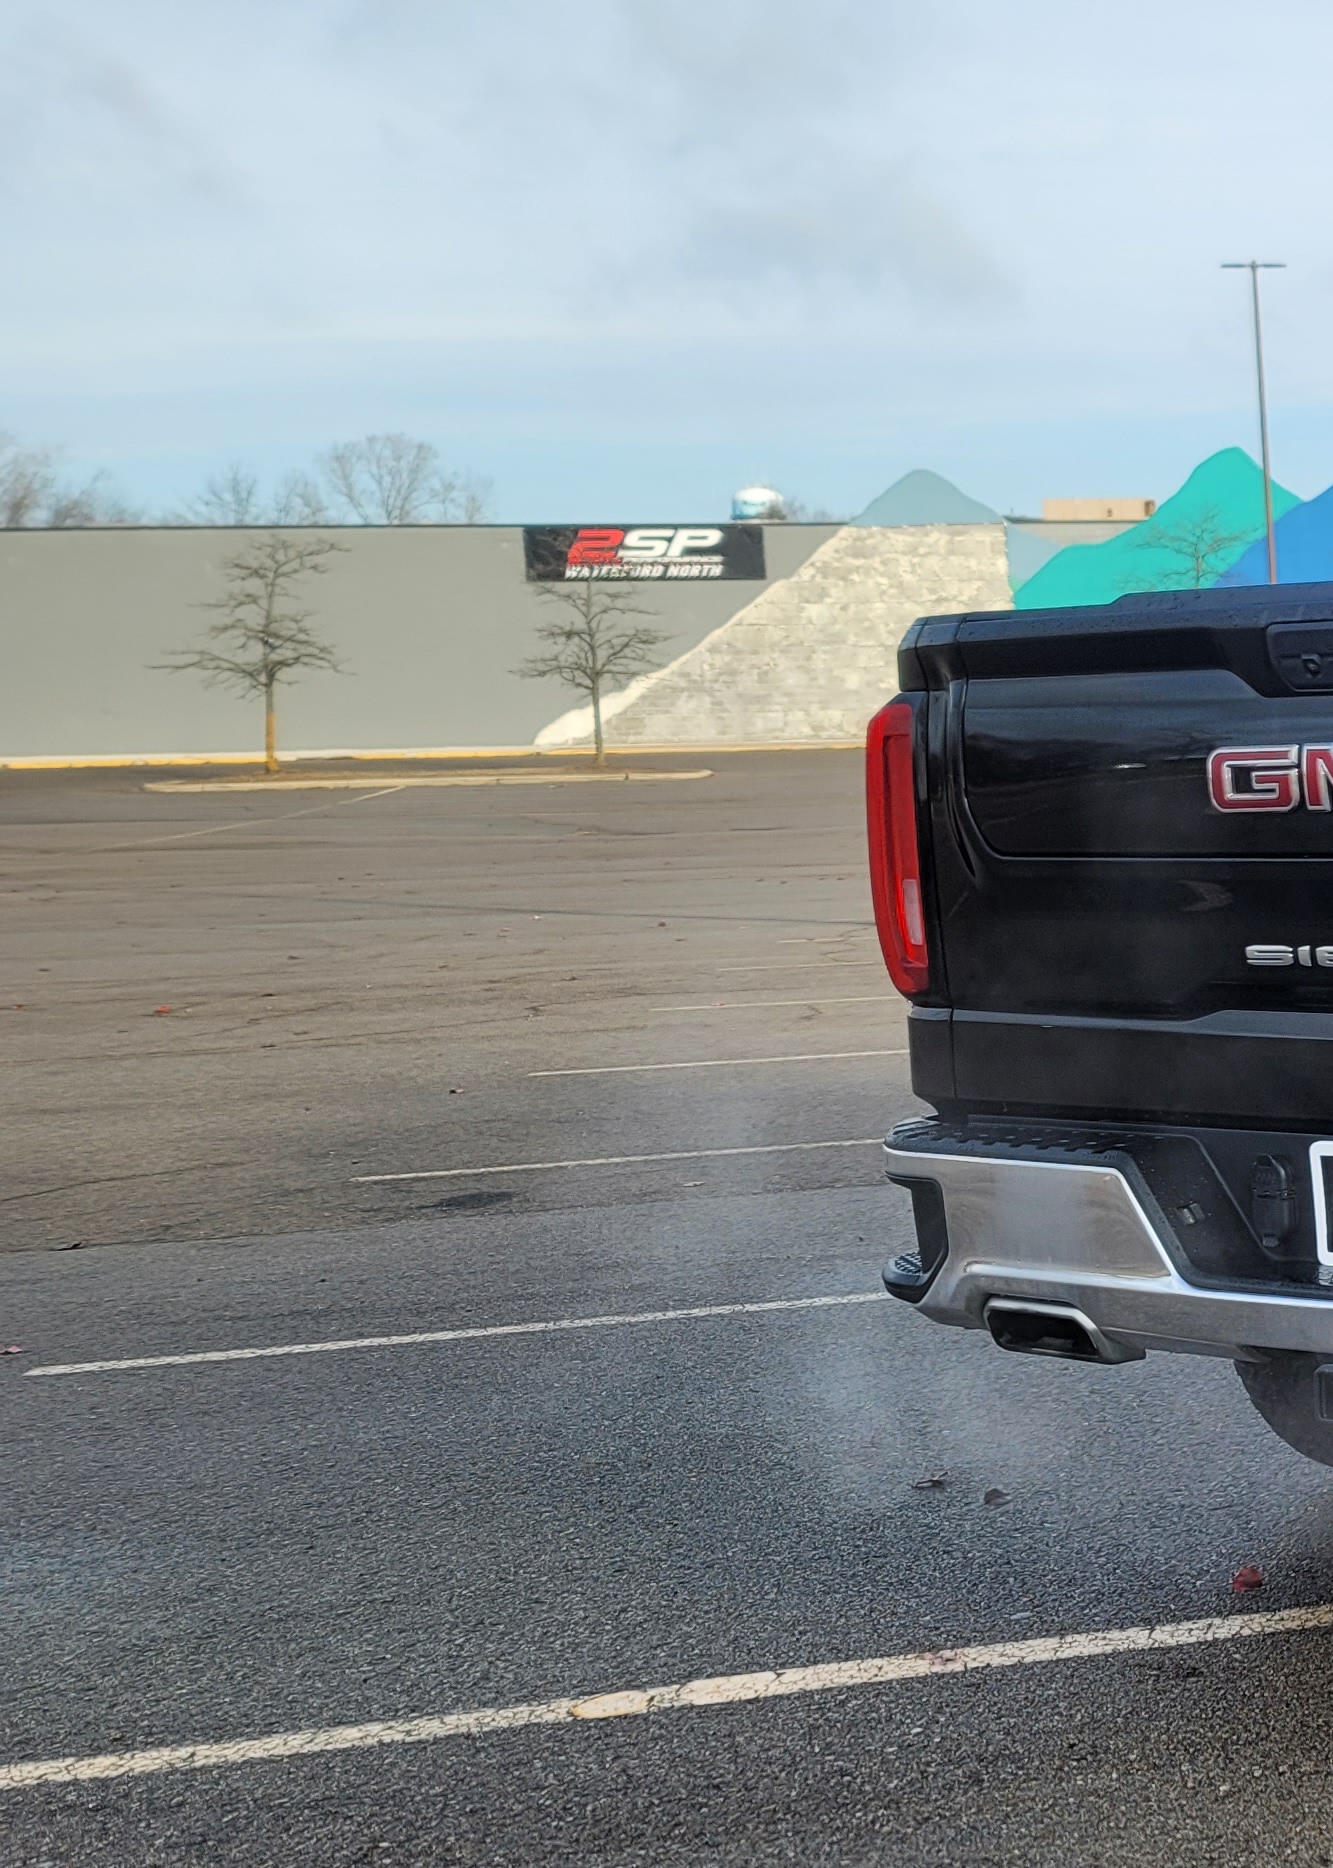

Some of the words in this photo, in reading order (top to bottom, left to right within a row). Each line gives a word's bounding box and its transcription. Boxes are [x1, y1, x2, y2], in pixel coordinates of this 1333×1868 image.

[567, 528, 724, 565] 2SP
[564, 564, 665, 580] WATERFORD
[665, 563, 724, 579] NORTH
